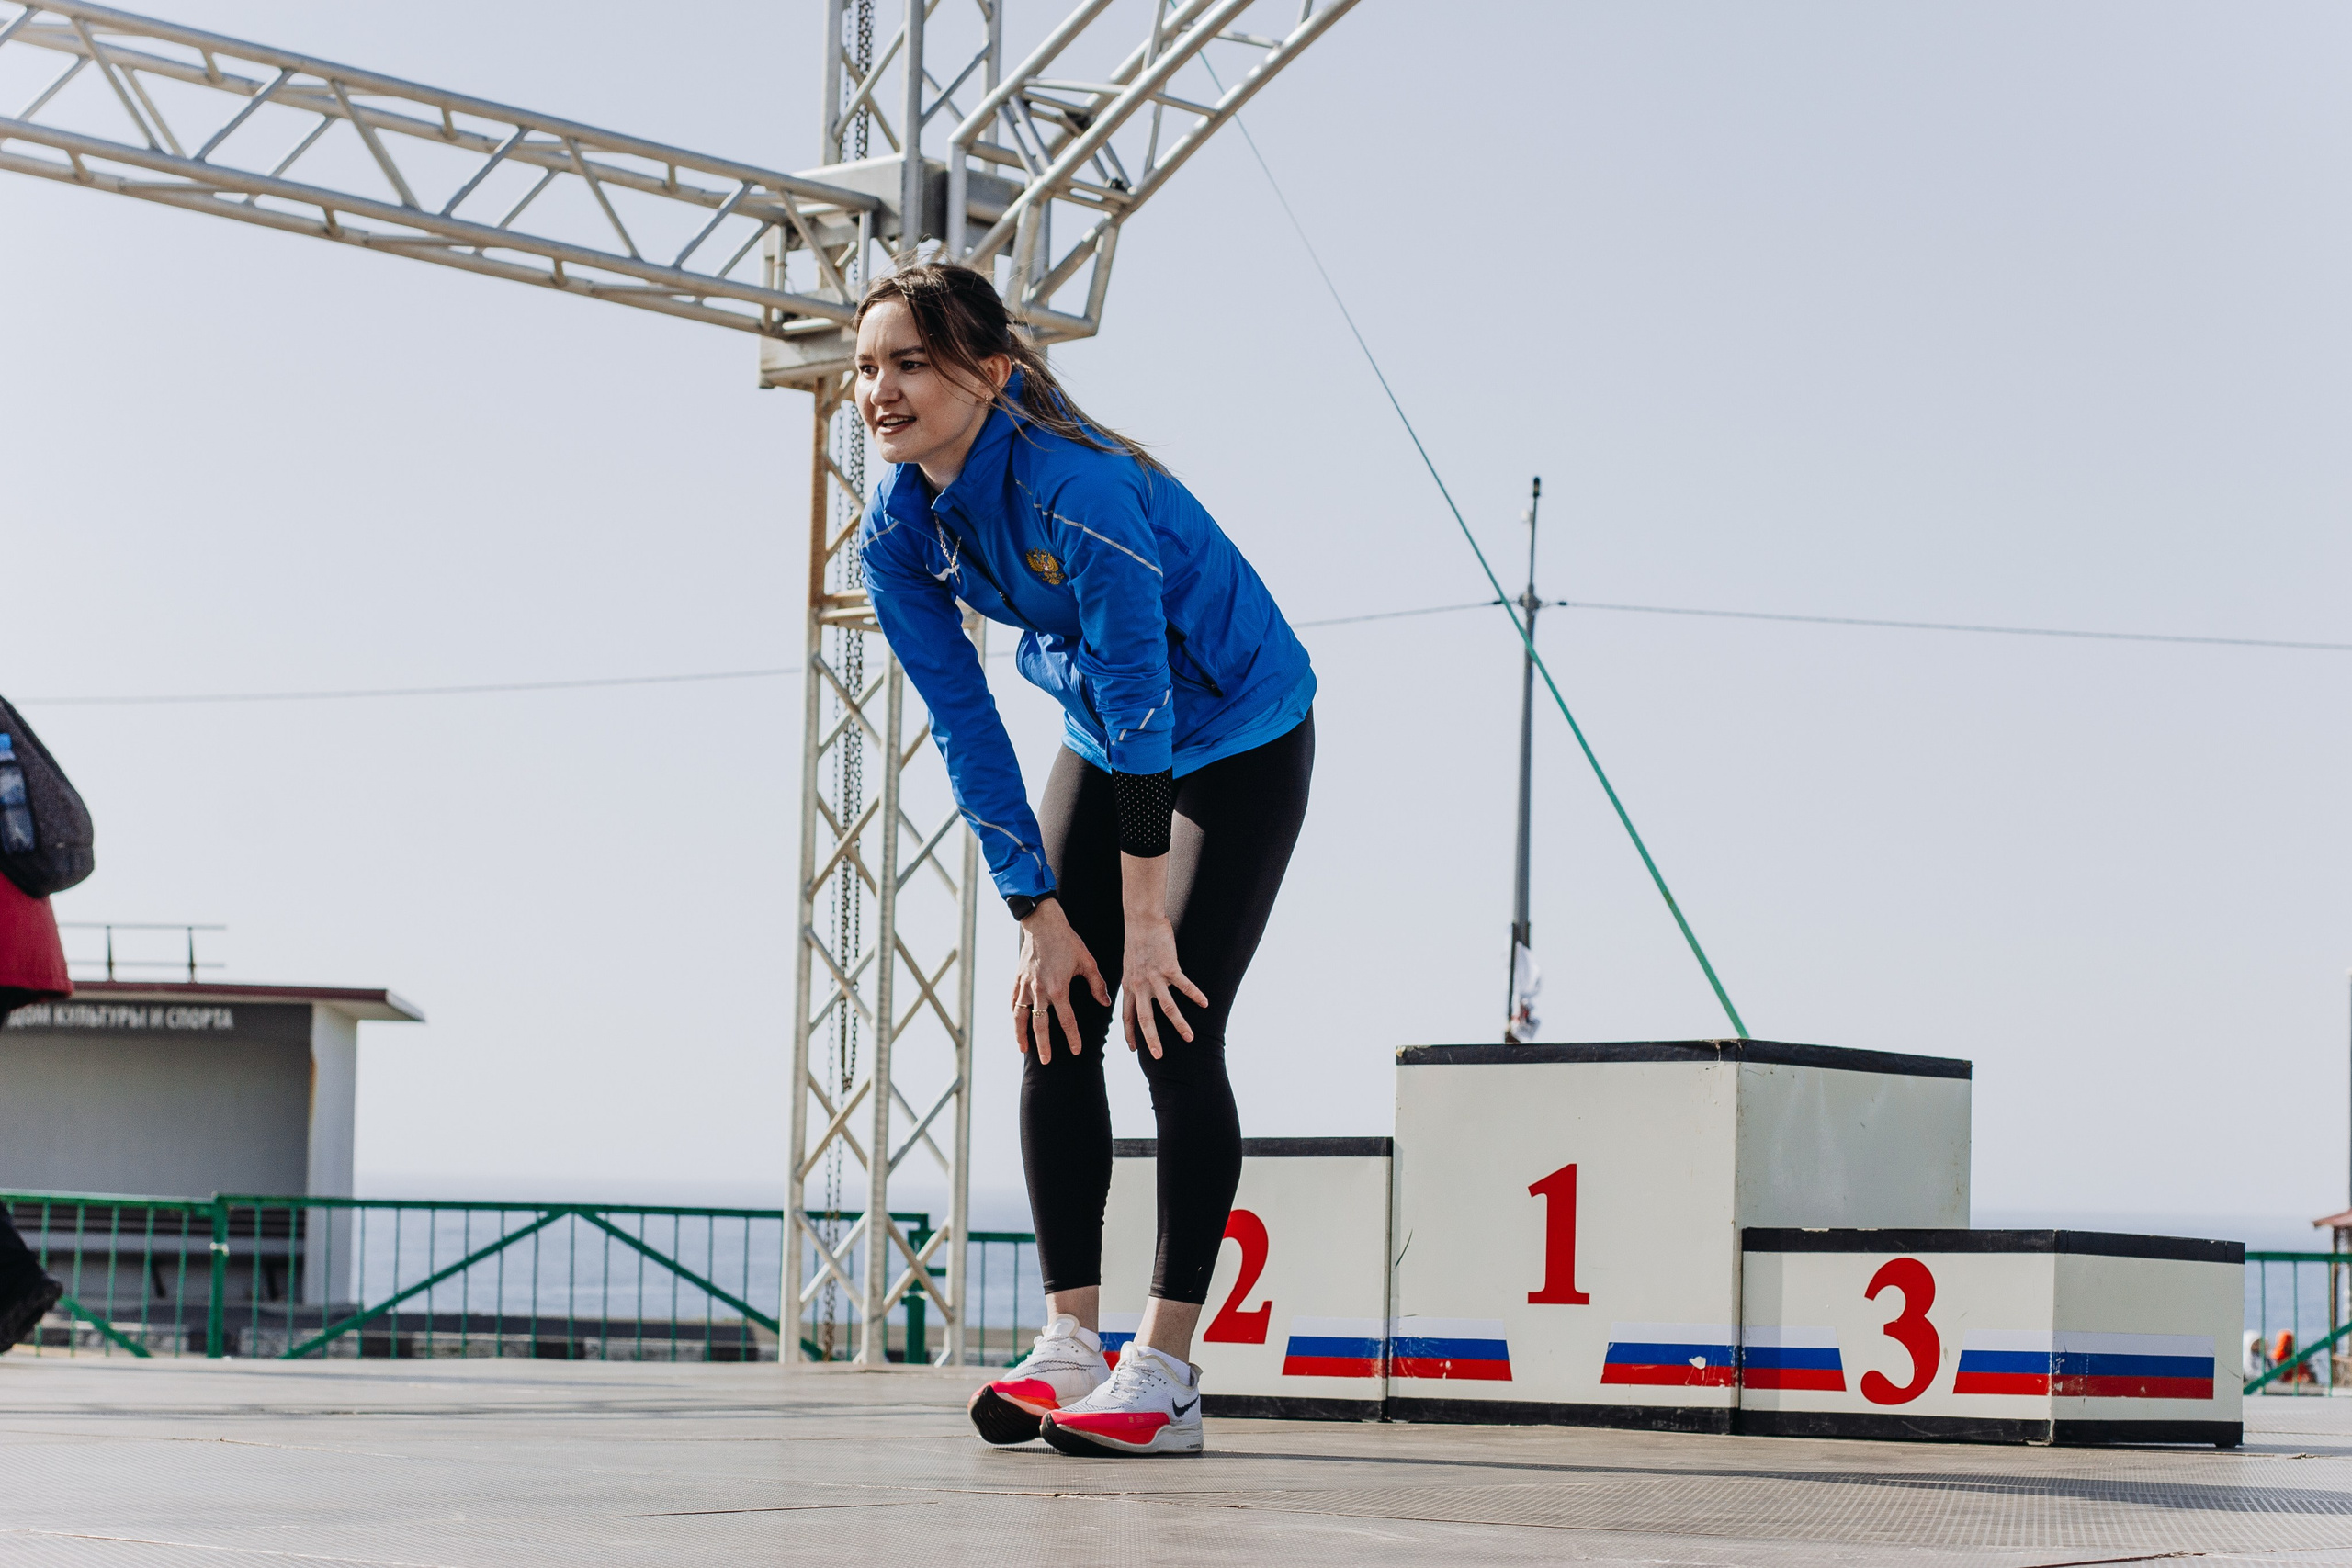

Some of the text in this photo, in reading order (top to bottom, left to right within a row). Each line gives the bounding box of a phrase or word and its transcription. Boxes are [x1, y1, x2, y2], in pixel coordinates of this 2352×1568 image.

[53, 1004, 147, 1029] КУЛЬТУРЫ
[149, 1006, 164, 1029] И
[165, 1006, 233, 1030] СПОРТА
[1203, 1209, 1272, 1344] 2
[1527, 1163, 1590, 1305] 1
[1860, 1257, 1941, 1405] 3
